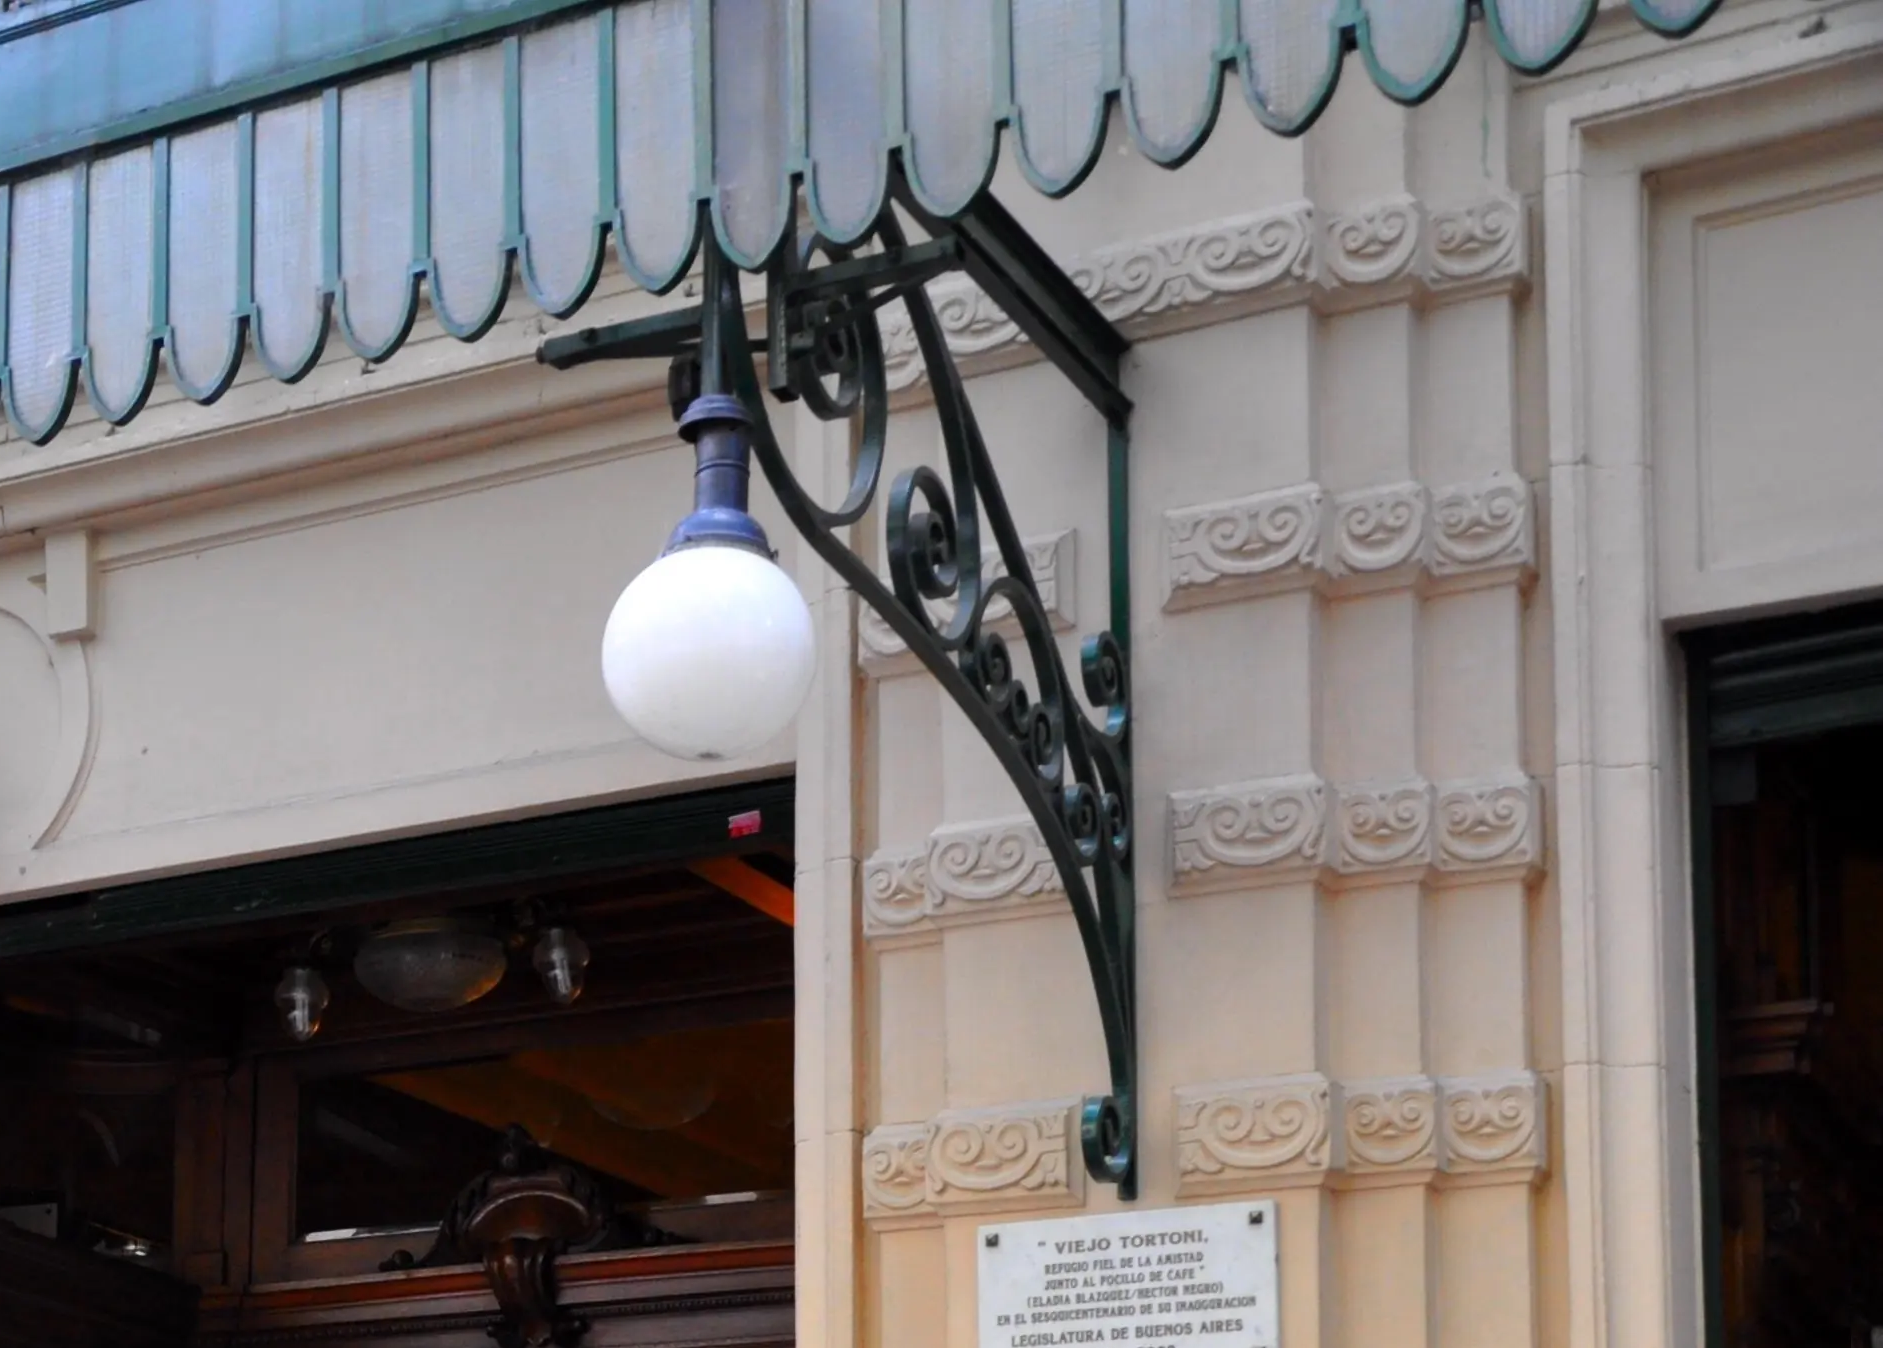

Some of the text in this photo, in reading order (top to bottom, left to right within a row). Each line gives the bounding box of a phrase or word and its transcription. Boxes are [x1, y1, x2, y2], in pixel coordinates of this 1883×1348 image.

[1055, 1239, 1111, 1255] VIEJO
[1044, 1252, 1204, 1275] REFUGIO FIEL DE LA AMISTAD
[1082, 1276, 1096, 1287] AL
[1100, 1273, 1145, 1286] POCILLO
[1149, 1271, 1163, 1282] DE
[1167, 1268, 1195, 1281] CAFE
[997, 1315, 1011, 1326] EN
[1015, 1313, 1027, 1324] EL
[1140, 1304, 1153, 1315] DE
[1158, 1302, 1172, 1313] SU
[1011, 1319, 1243, 1348] LEGISLATURA DE BUENOS AIRES
